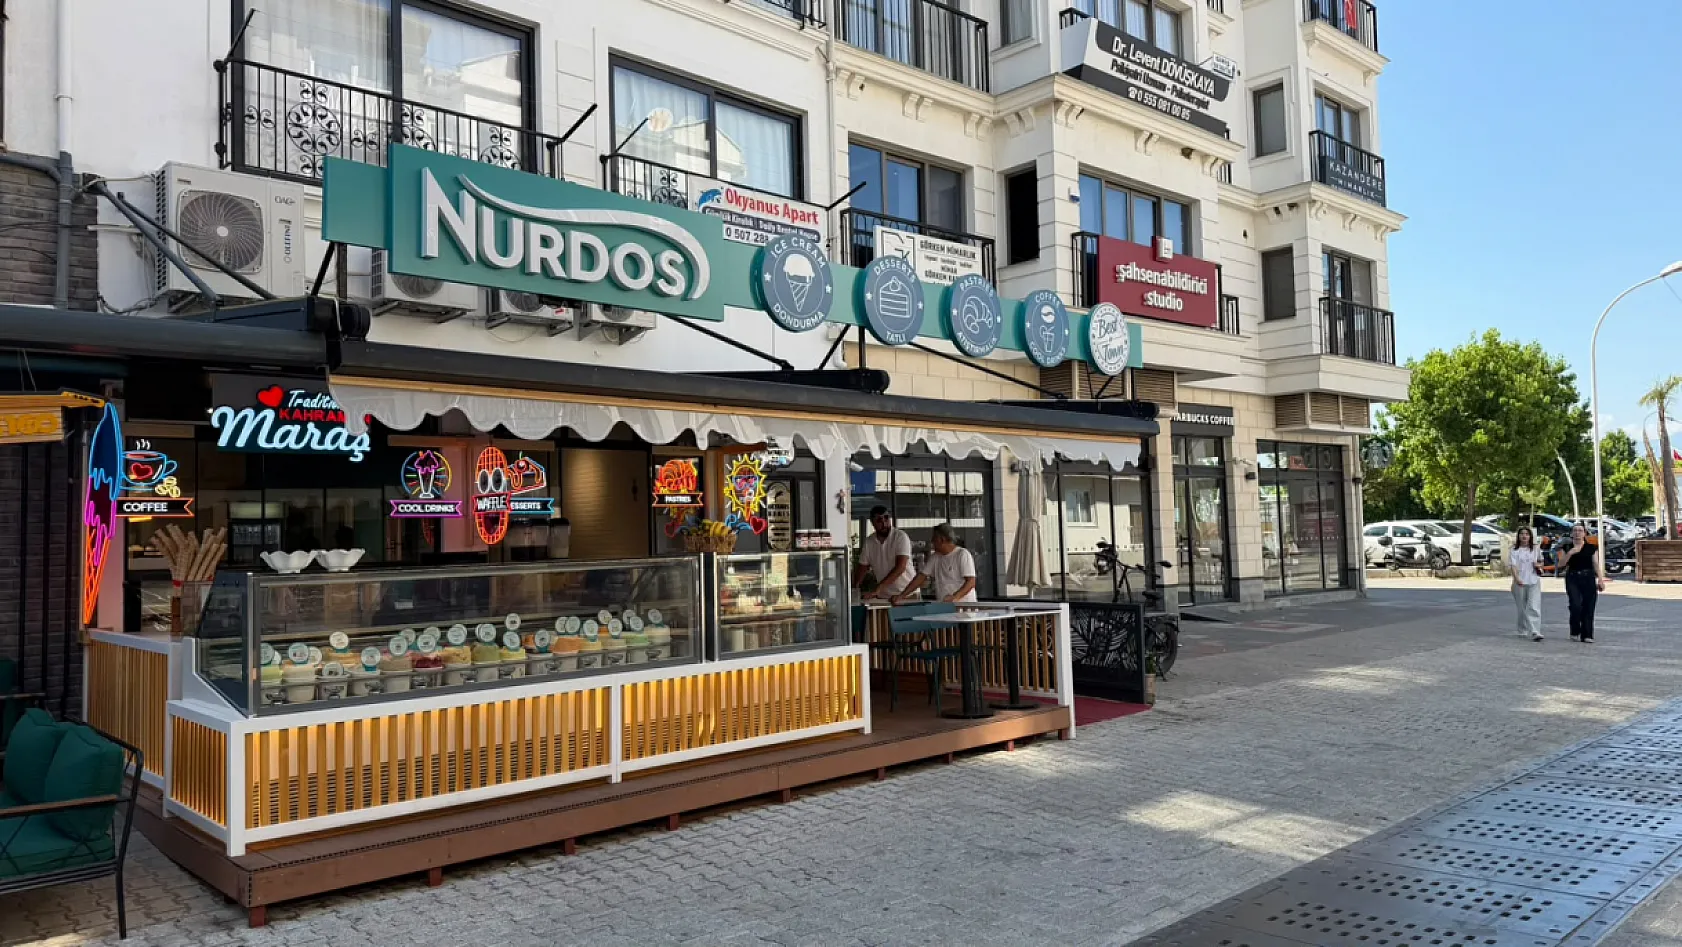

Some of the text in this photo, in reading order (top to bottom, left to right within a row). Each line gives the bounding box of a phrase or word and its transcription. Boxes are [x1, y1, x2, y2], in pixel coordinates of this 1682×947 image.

[1112, 36, 1128, 58] Dr.
[1130, 44, 1161, 72] Levent
[1161, 58, 1215, 96] DÖVÜŞKAYA
[1329, 161, 1383, 191] KAZANDERE
[725, 188, 819, 225] Okyanus Apart
[420, 166, 686, 298] NURDOS
[726, 227, 732, 237] 0
[770, 237, 827, 269] ICE CREAM
[873, 258, 917, 284] DESSERTS
[960, 276, 994, 298] PASTRIES
[1035, 292, 1061, 308] COFFEE
[1143, 290, 1183, 312] studio
[773, 303, 825, 329] DONDURMA
[886, 330, 907, 342] TATLI
[211, 405, 371, 462] Maraş
[122, 502, 169, 512] COFFEE
[397, 503, 456, 513] COOL DRINKS
[476, 496, 508, 512] WAFFLE
